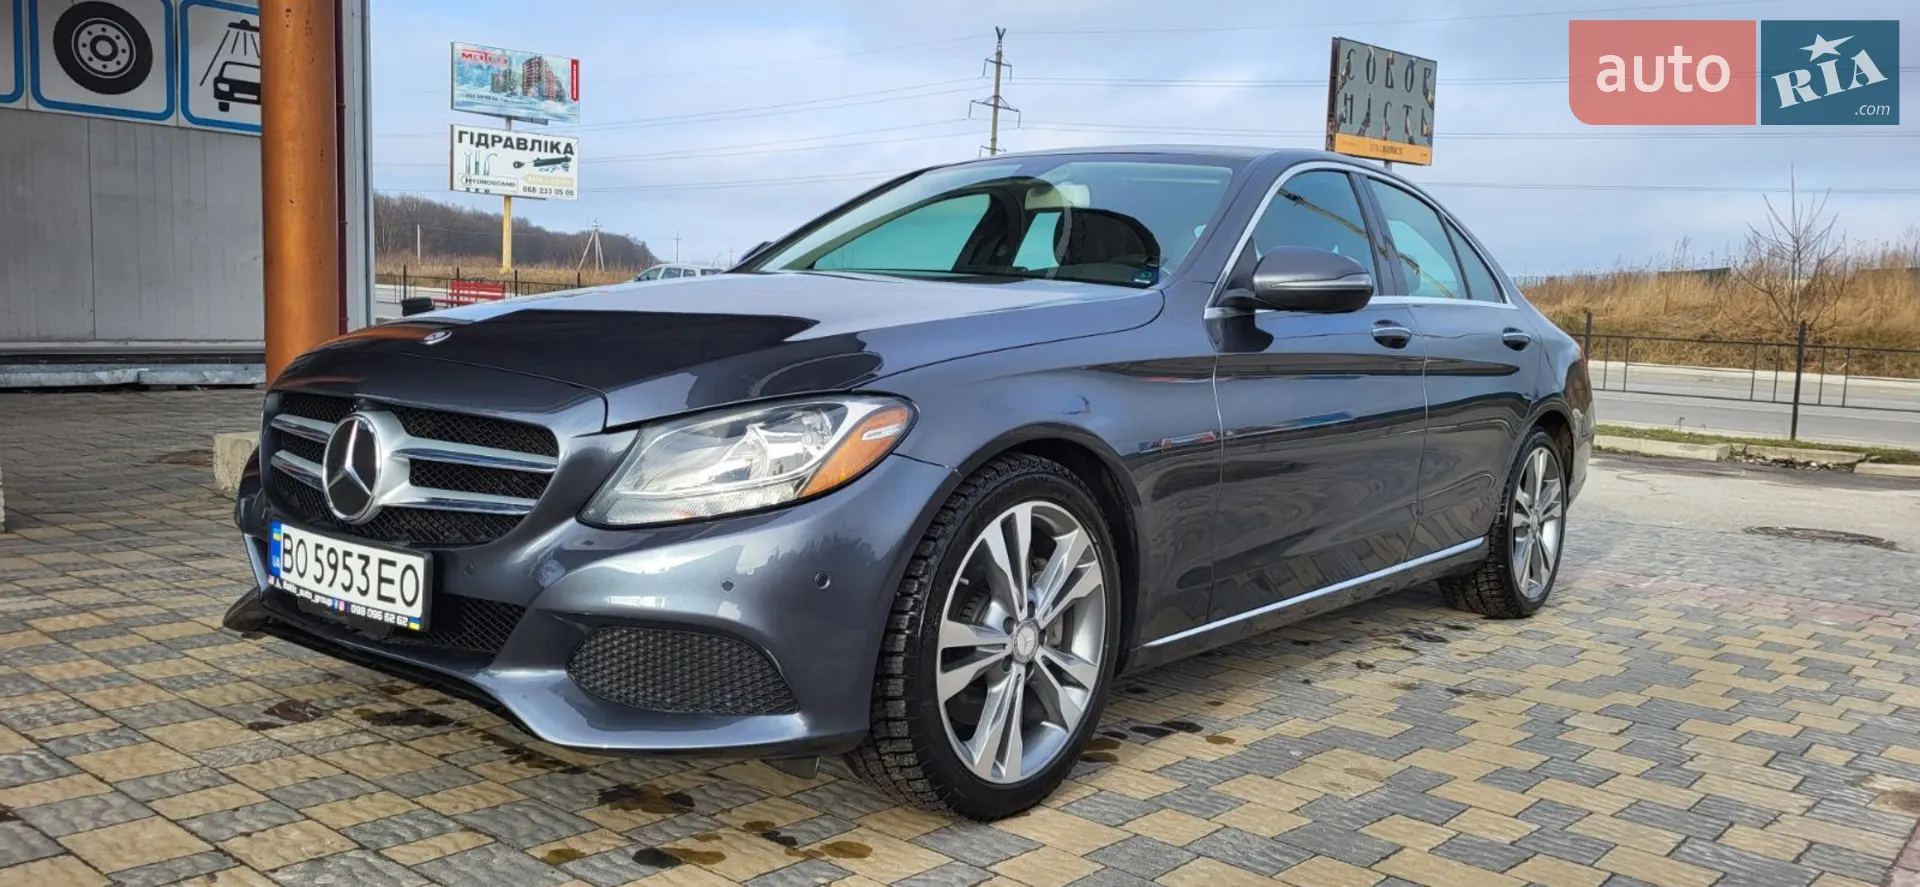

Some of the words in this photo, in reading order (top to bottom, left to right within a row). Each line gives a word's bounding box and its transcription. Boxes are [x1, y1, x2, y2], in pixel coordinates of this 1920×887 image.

[458, 131, 574, 156] ГІДРАВЛІКА
[282, 532, 308, 579] BO
[313, 543, 371, 597] 5953
[377, 558, 420, 608] EO
